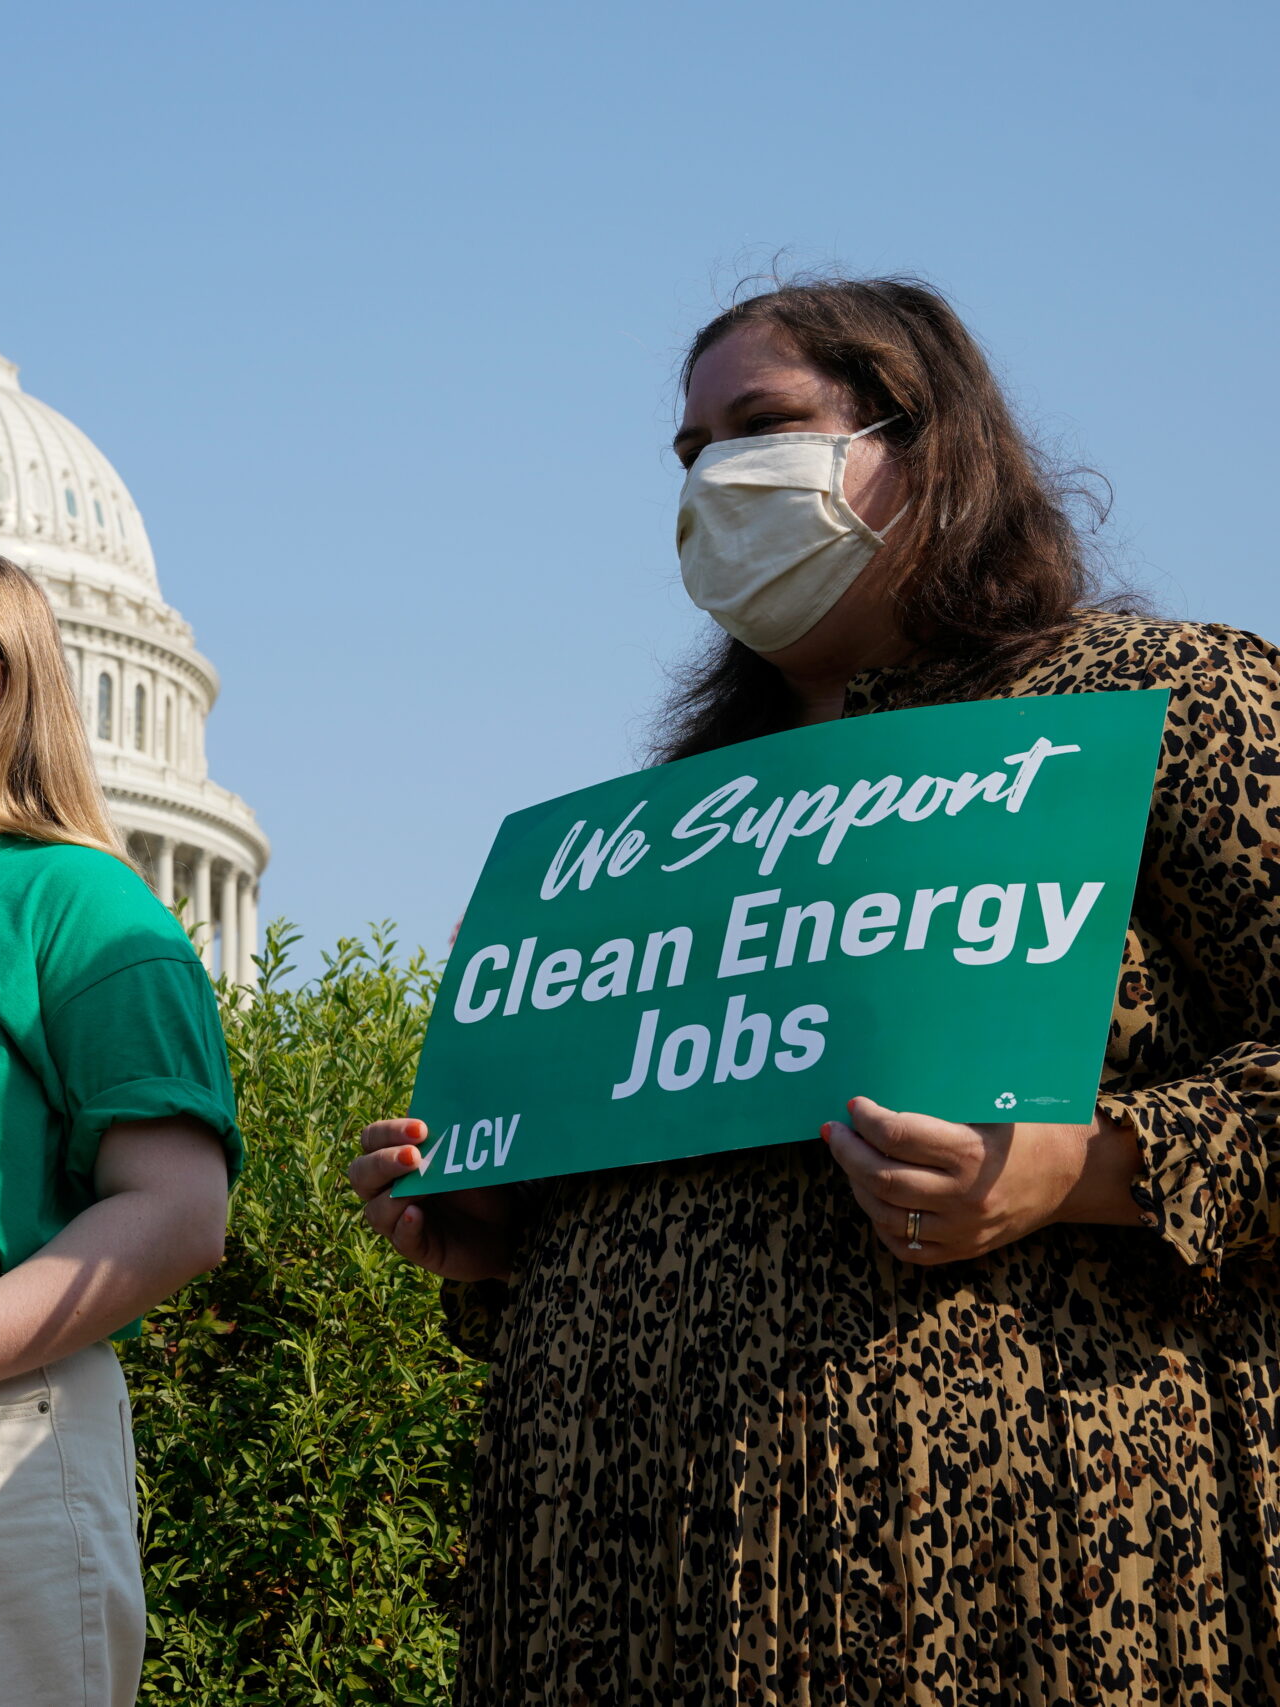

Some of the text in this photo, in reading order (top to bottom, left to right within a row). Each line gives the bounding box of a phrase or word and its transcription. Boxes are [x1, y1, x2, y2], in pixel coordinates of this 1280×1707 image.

[540, 737, 1081, 900] We Support
[454, 882, 1105, 1023] Clean Energy
[612, 995, 828, 1099] Jobs
[444, 1114, 521, 1174] LCV
